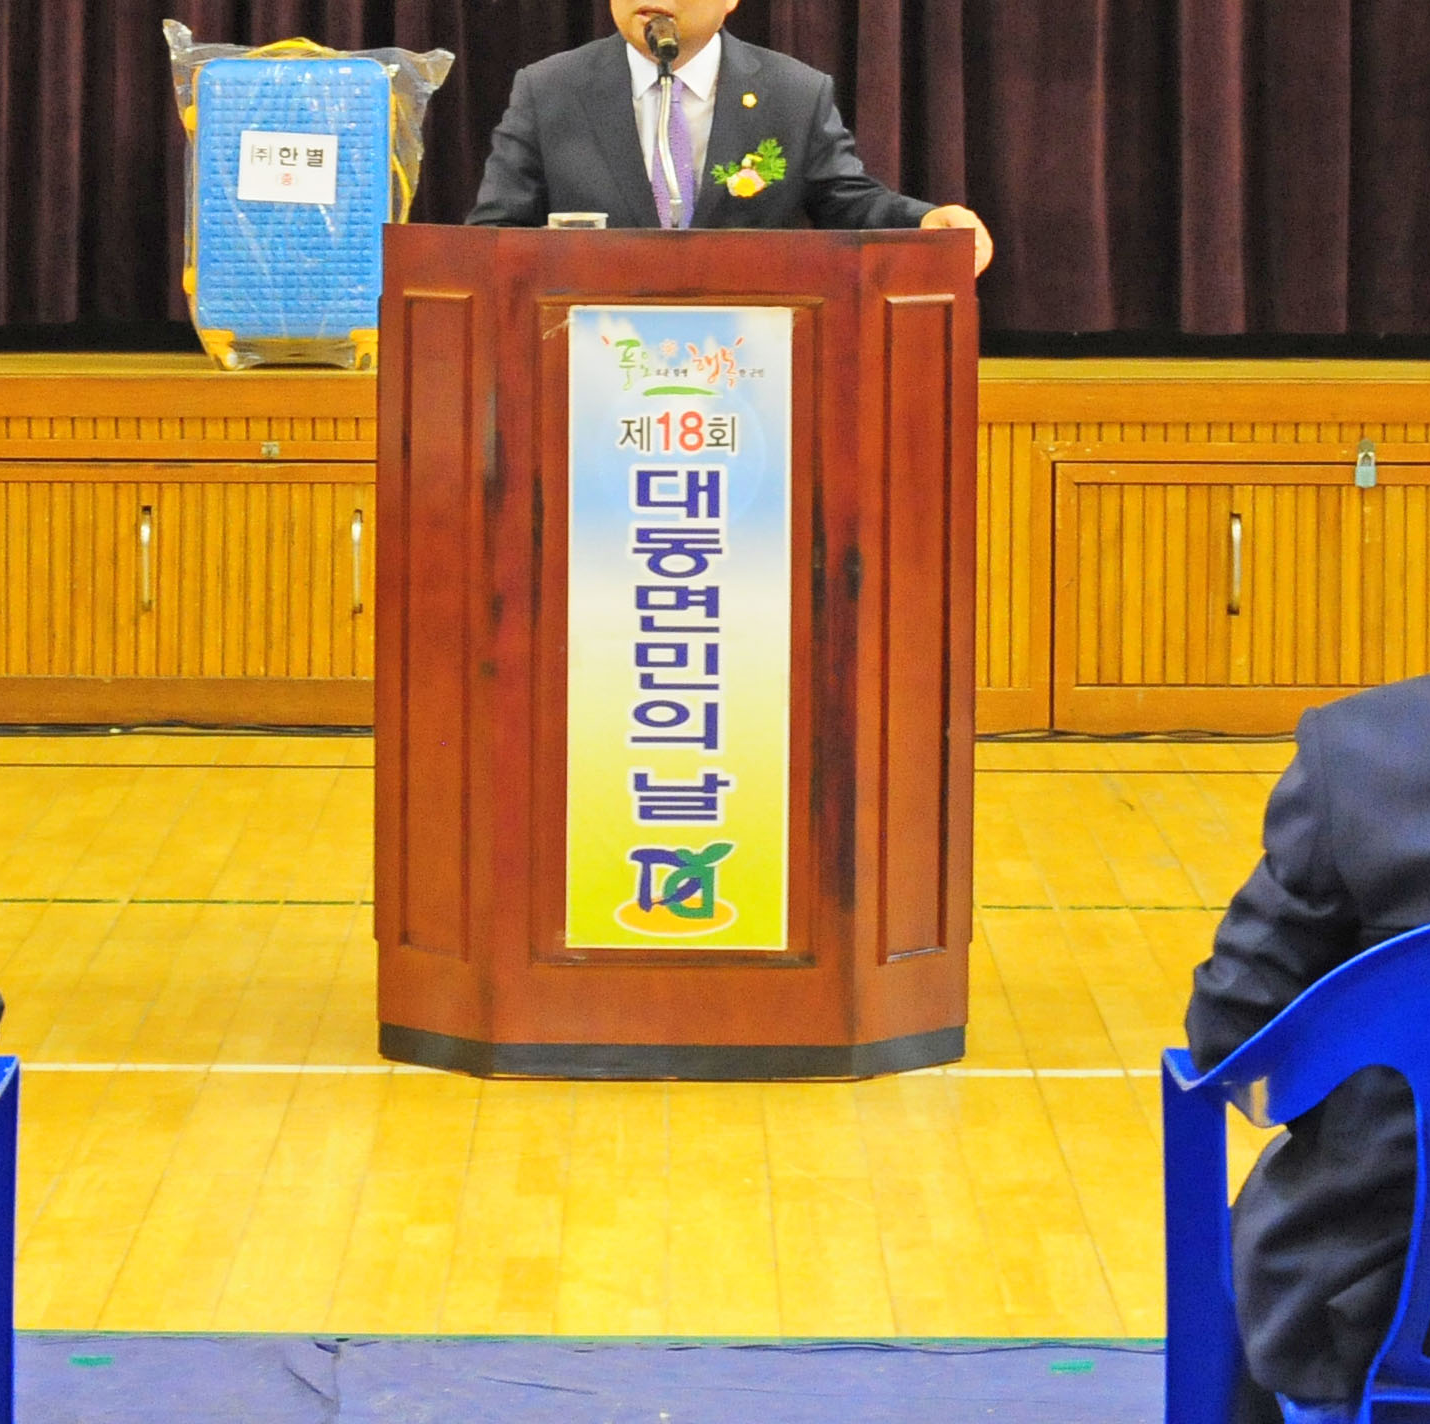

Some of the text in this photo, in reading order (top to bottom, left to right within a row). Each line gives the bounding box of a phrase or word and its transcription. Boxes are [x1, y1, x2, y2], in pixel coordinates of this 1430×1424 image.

[618, 410, 736, 453] 제18회
[631, 469, 730, 821] 대동면민의 날
